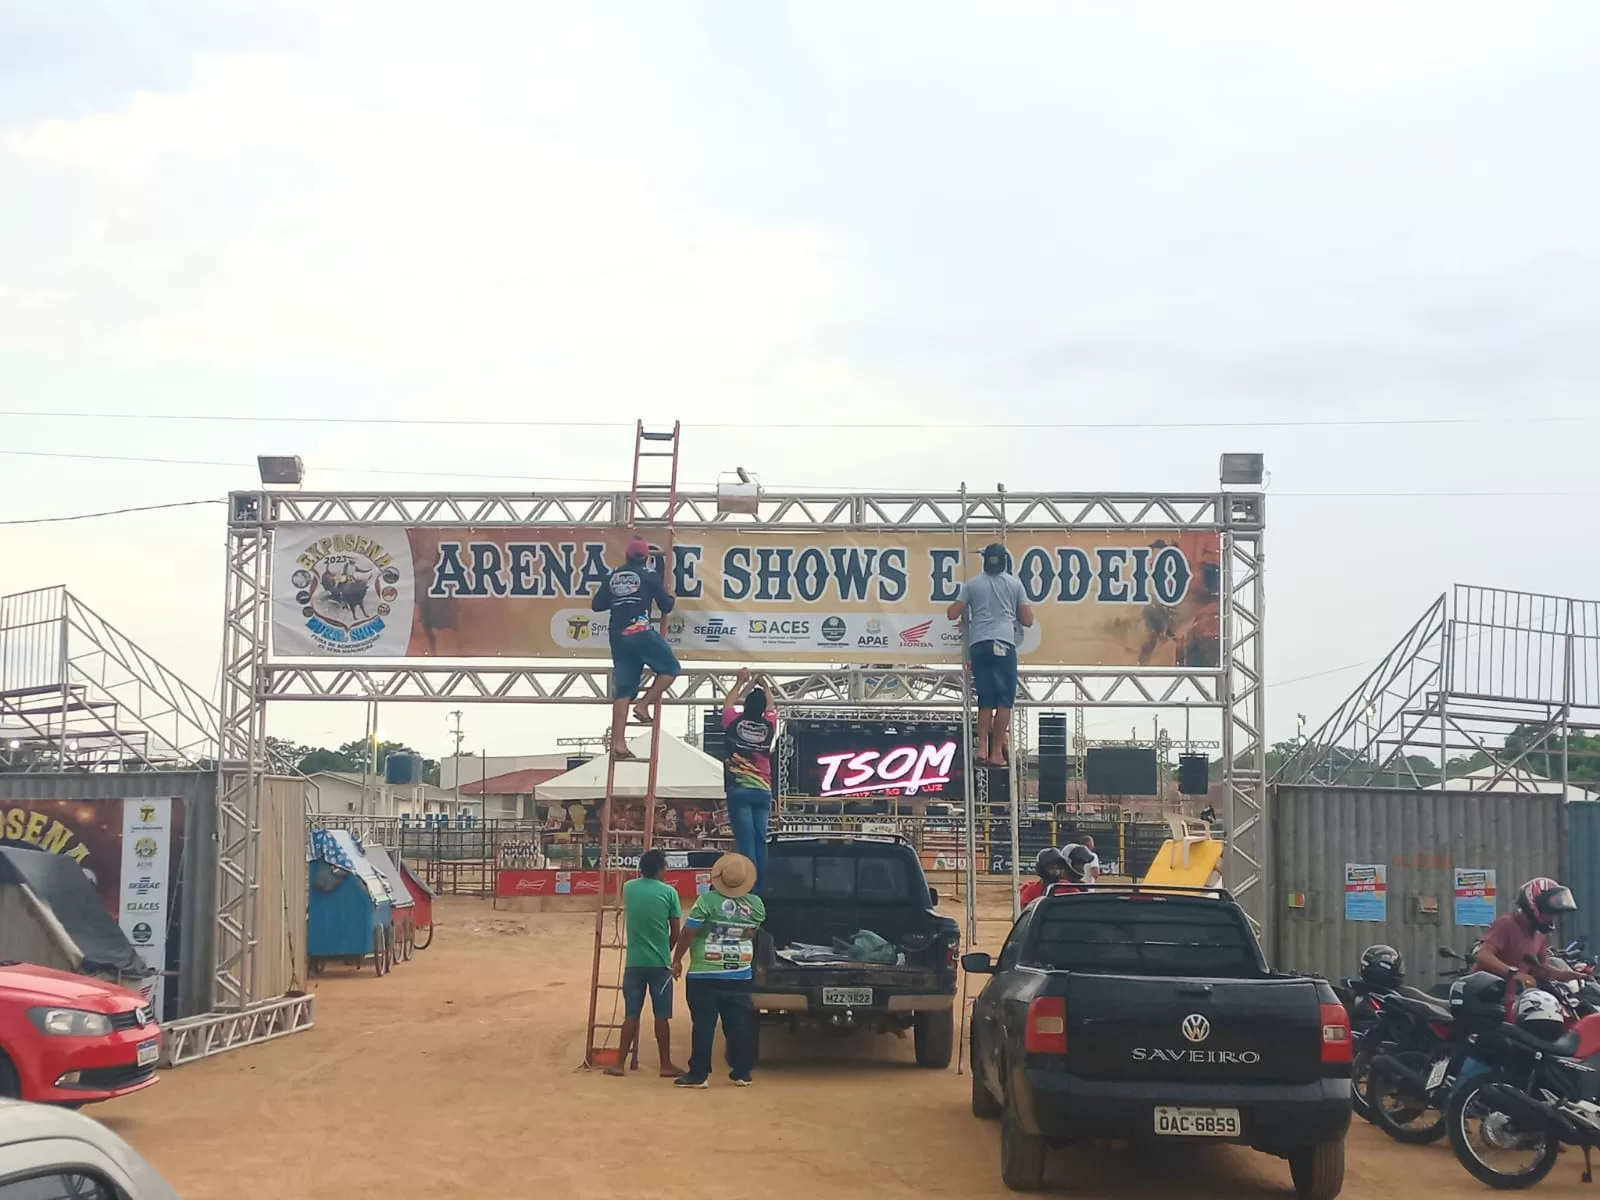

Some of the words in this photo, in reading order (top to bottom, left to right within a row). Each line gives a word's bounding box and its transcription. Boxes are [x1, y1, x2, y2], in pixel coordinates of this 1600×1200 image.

[296, 534, 394, 570] EXPOSENA
[323, 555, 348, 565] 2023
[428, 541, 611, 599] ARENA
[722, 545, 909, 603] SHOWS
[929, 548, 963, 603] E
[1004, 546, 1193, 606] ODEIO
[693, 626, 737, 636] SEBRAE
[769, 621, 809, 634] ACES
[858, 636, 889, 646] APAE
[816, 740, 958, 796] TSOM
[137, 902, 160, 911] ACES
[1132, 1047, 1260, 1064] SAVEIRO
